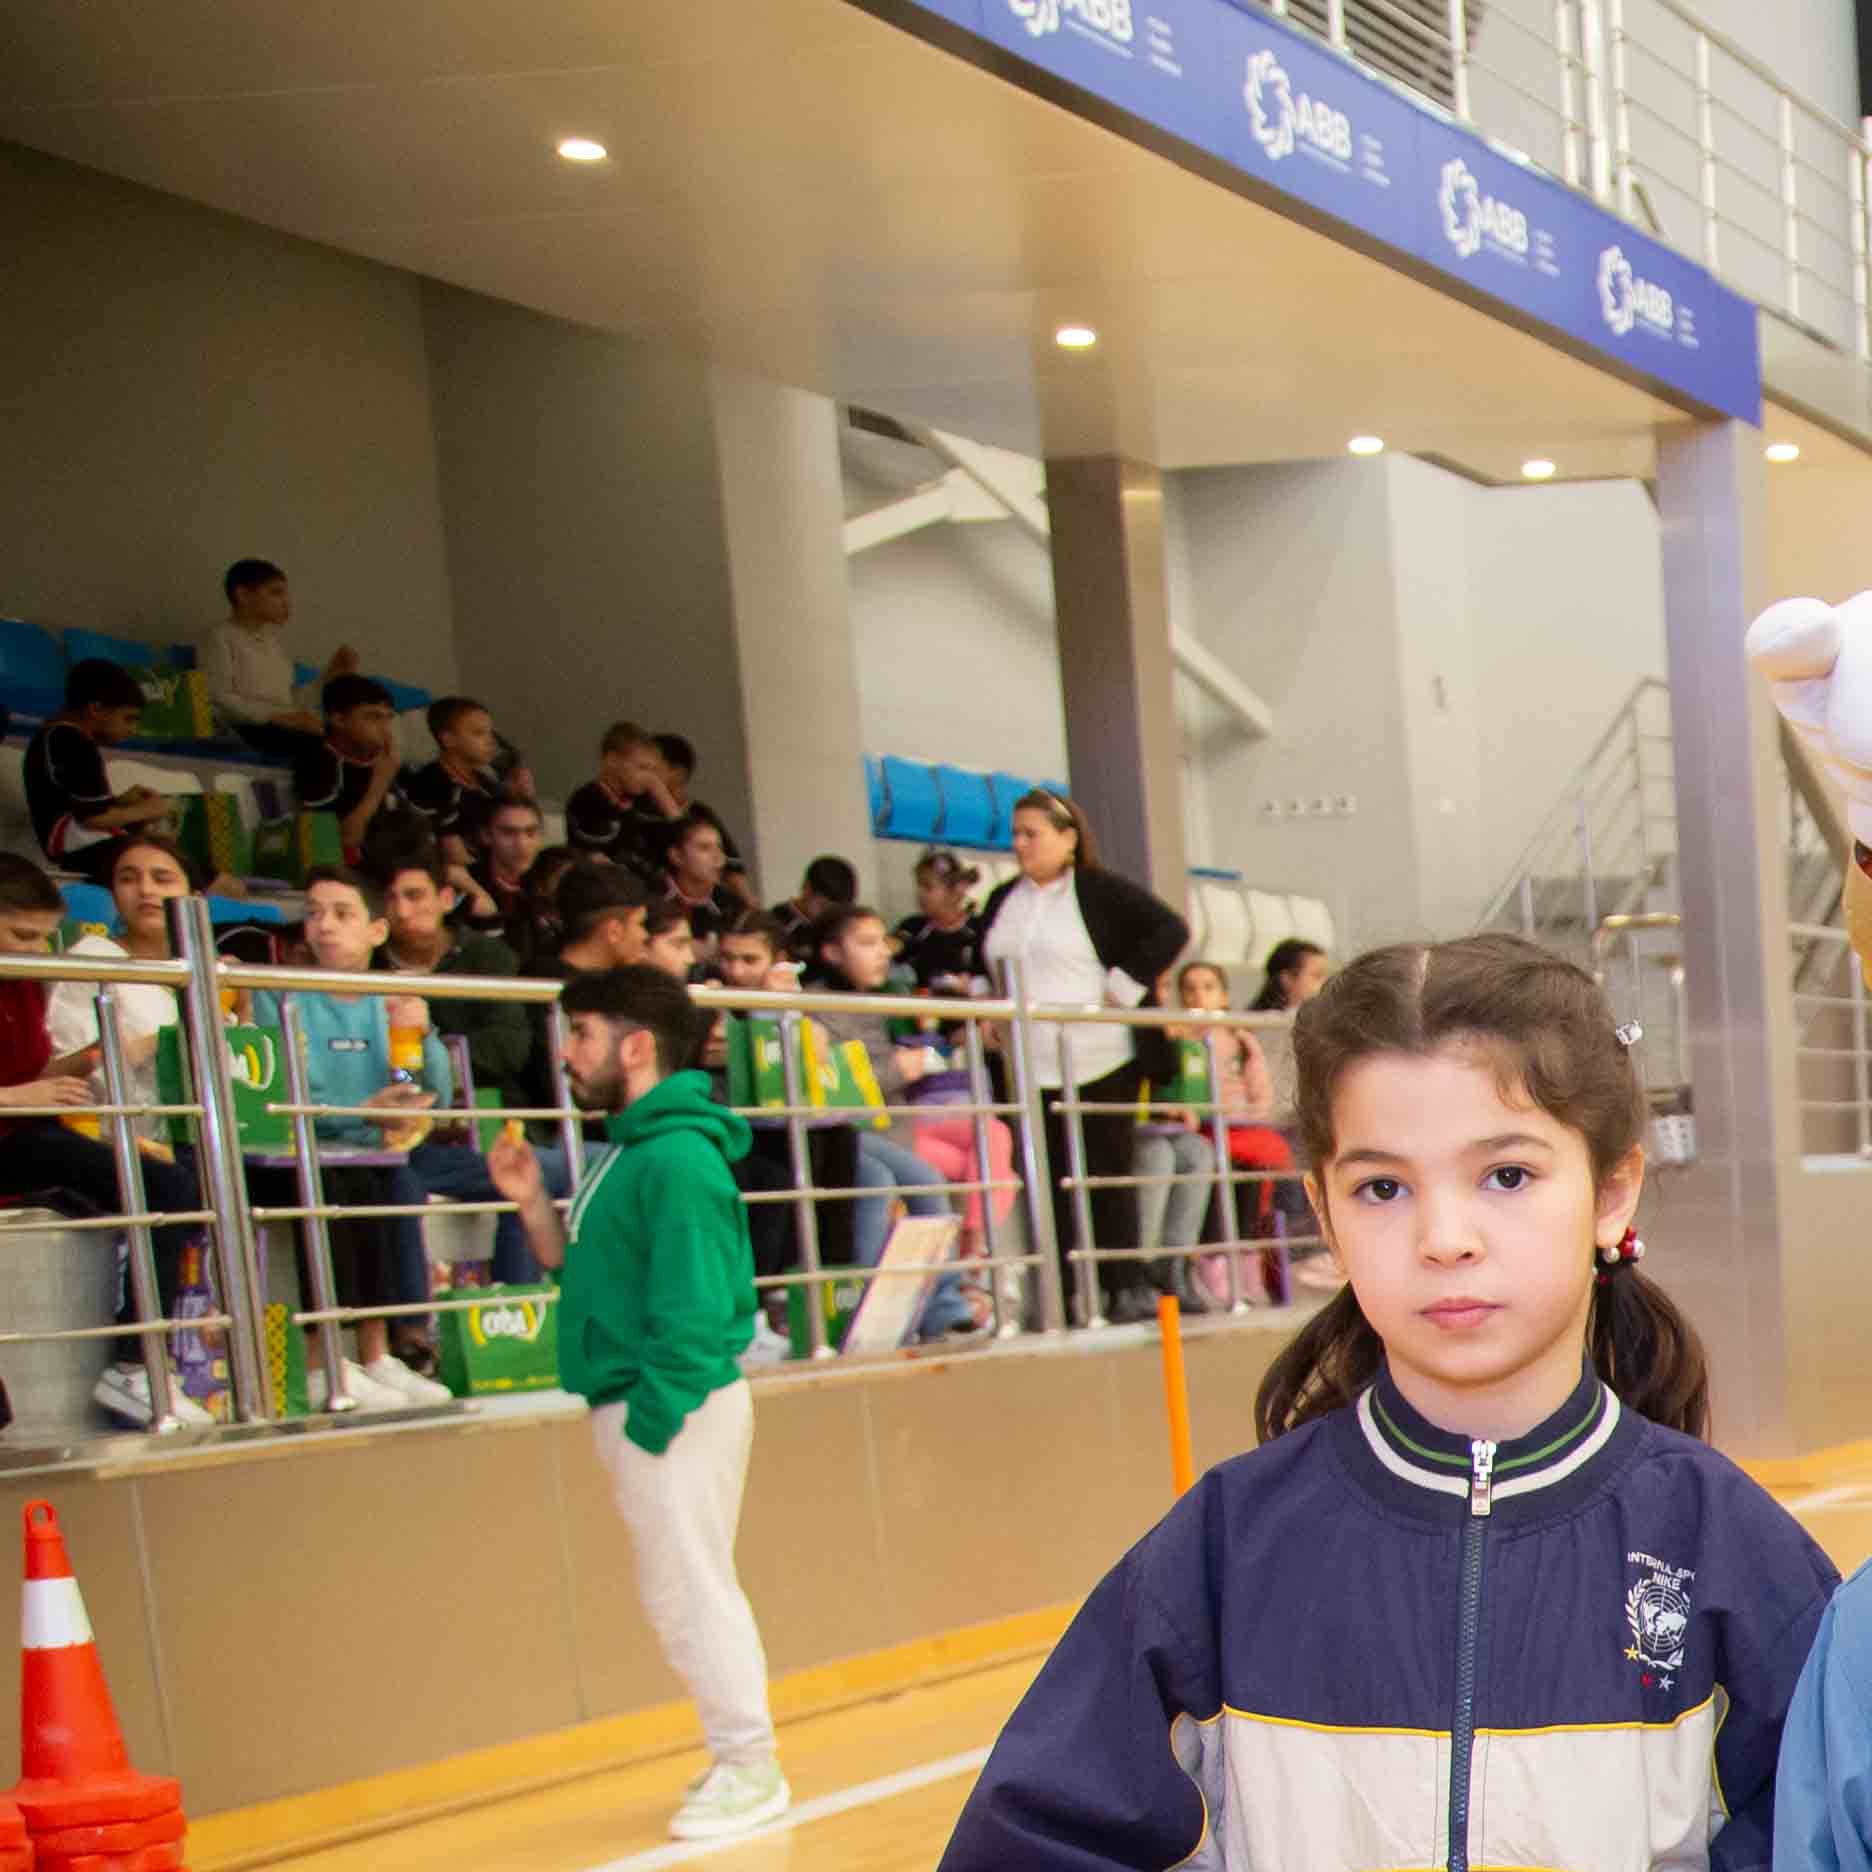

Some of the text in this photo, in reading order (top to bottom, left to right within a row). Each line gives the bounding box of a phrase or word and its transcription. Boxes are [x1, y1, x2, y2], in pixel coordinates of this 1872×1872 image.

[1062, 0, 1134, 42] BB
[1295, 92, 1353, 161] ABB
[1652, 1571, 1681, 1591] NIKE
